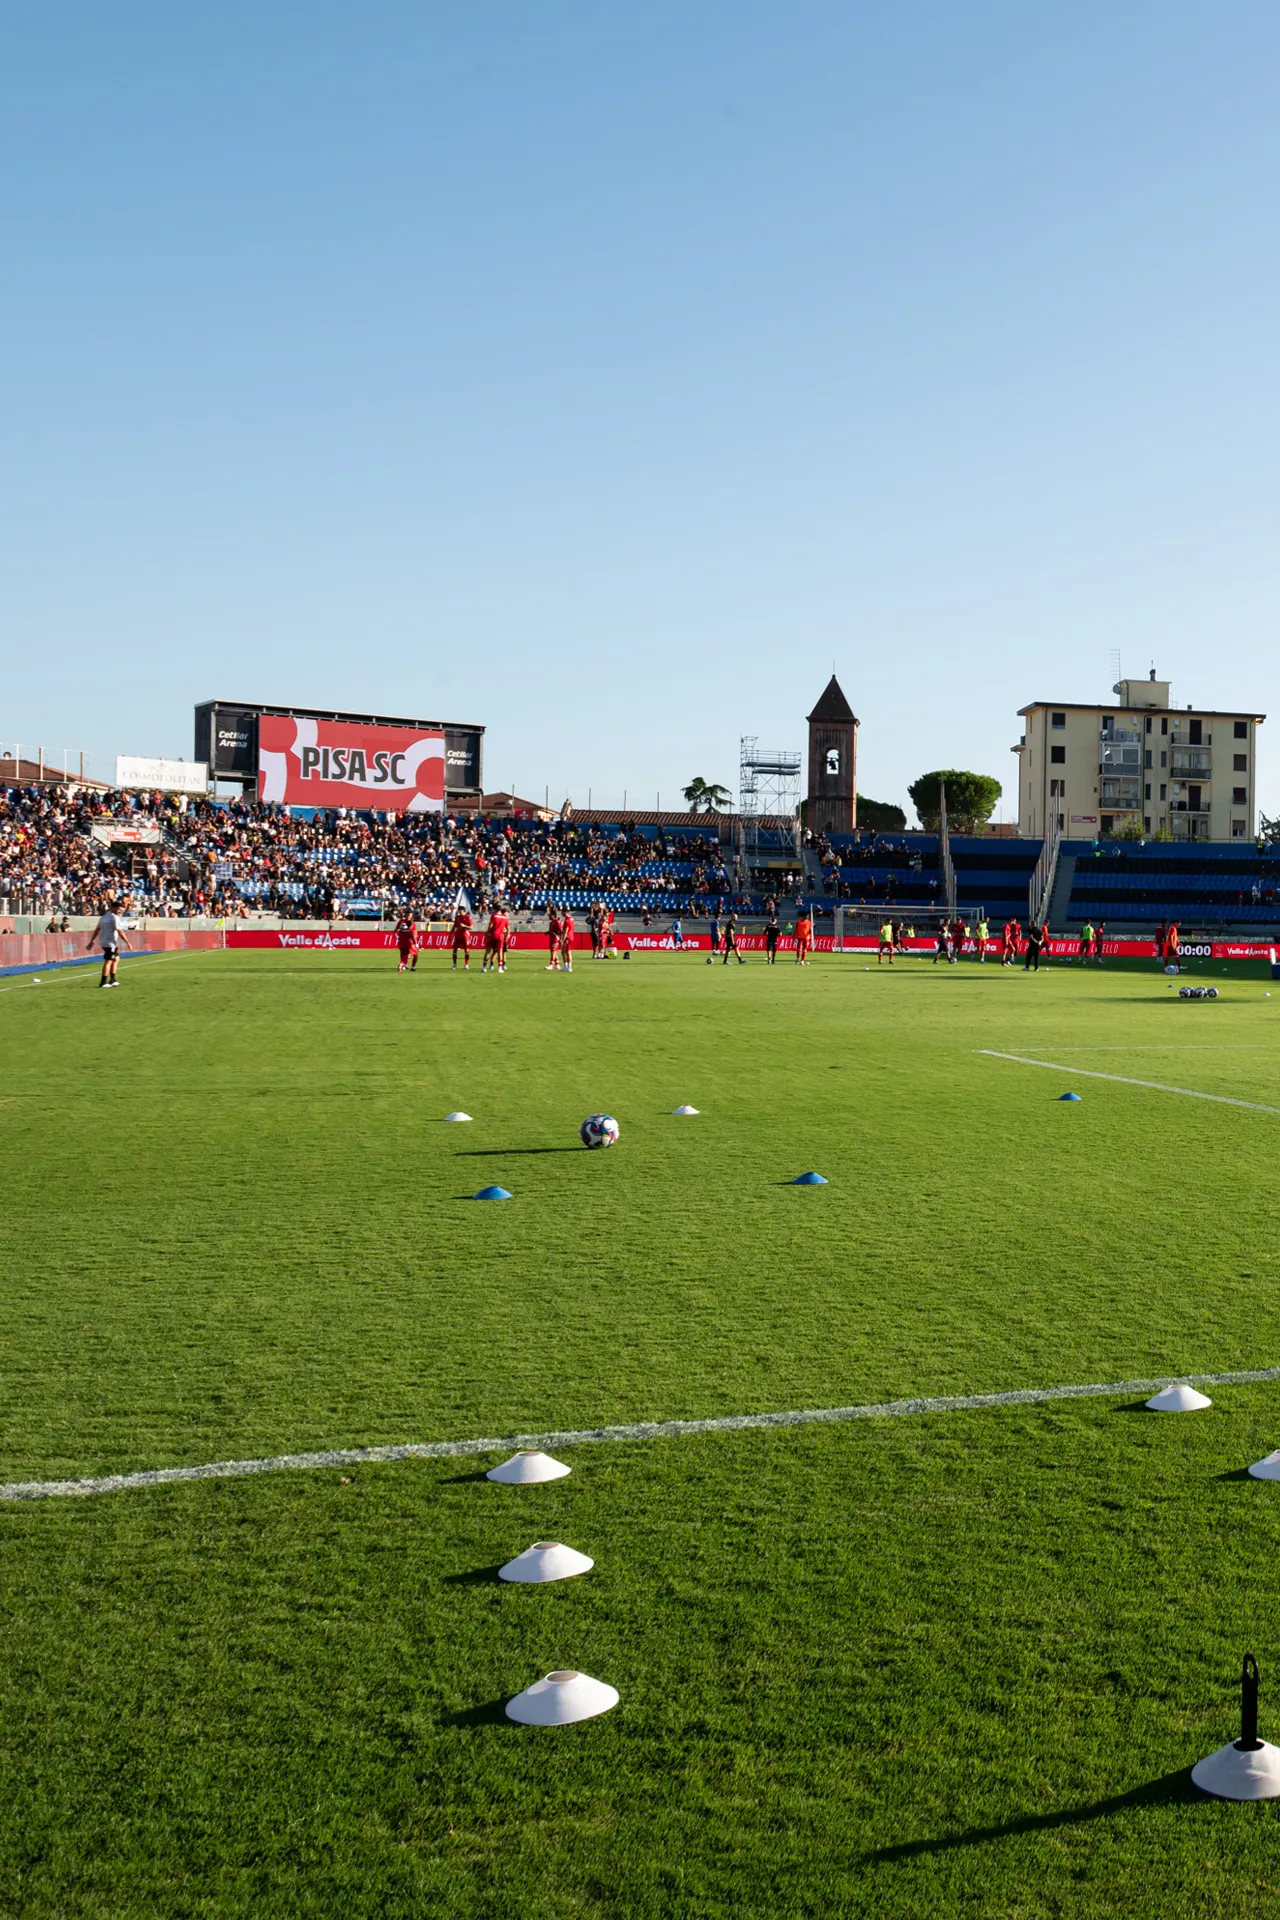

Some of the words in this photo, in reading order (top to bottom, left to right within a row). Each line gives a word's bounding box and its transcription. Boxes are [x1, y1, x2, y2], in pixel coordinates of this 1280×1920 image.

[218, 730, 248, 739] Cetillar
[218, 739, 247, 748] Arena
[302, 746, 367, 782] PISA
[373, 752, 406, 785] SC
[447, 757, 472, 767] Arena
[122, 770, 201, 785] COSMOPOLITAN
[278, 933, 313, 947] Valle
[314, 931, 360, 948] d'Aosta
[627, 936, 658, 949] Valle
[1177, 944, 1211, 956] 00:00
[1227, 946, 1243, 956] Valle
